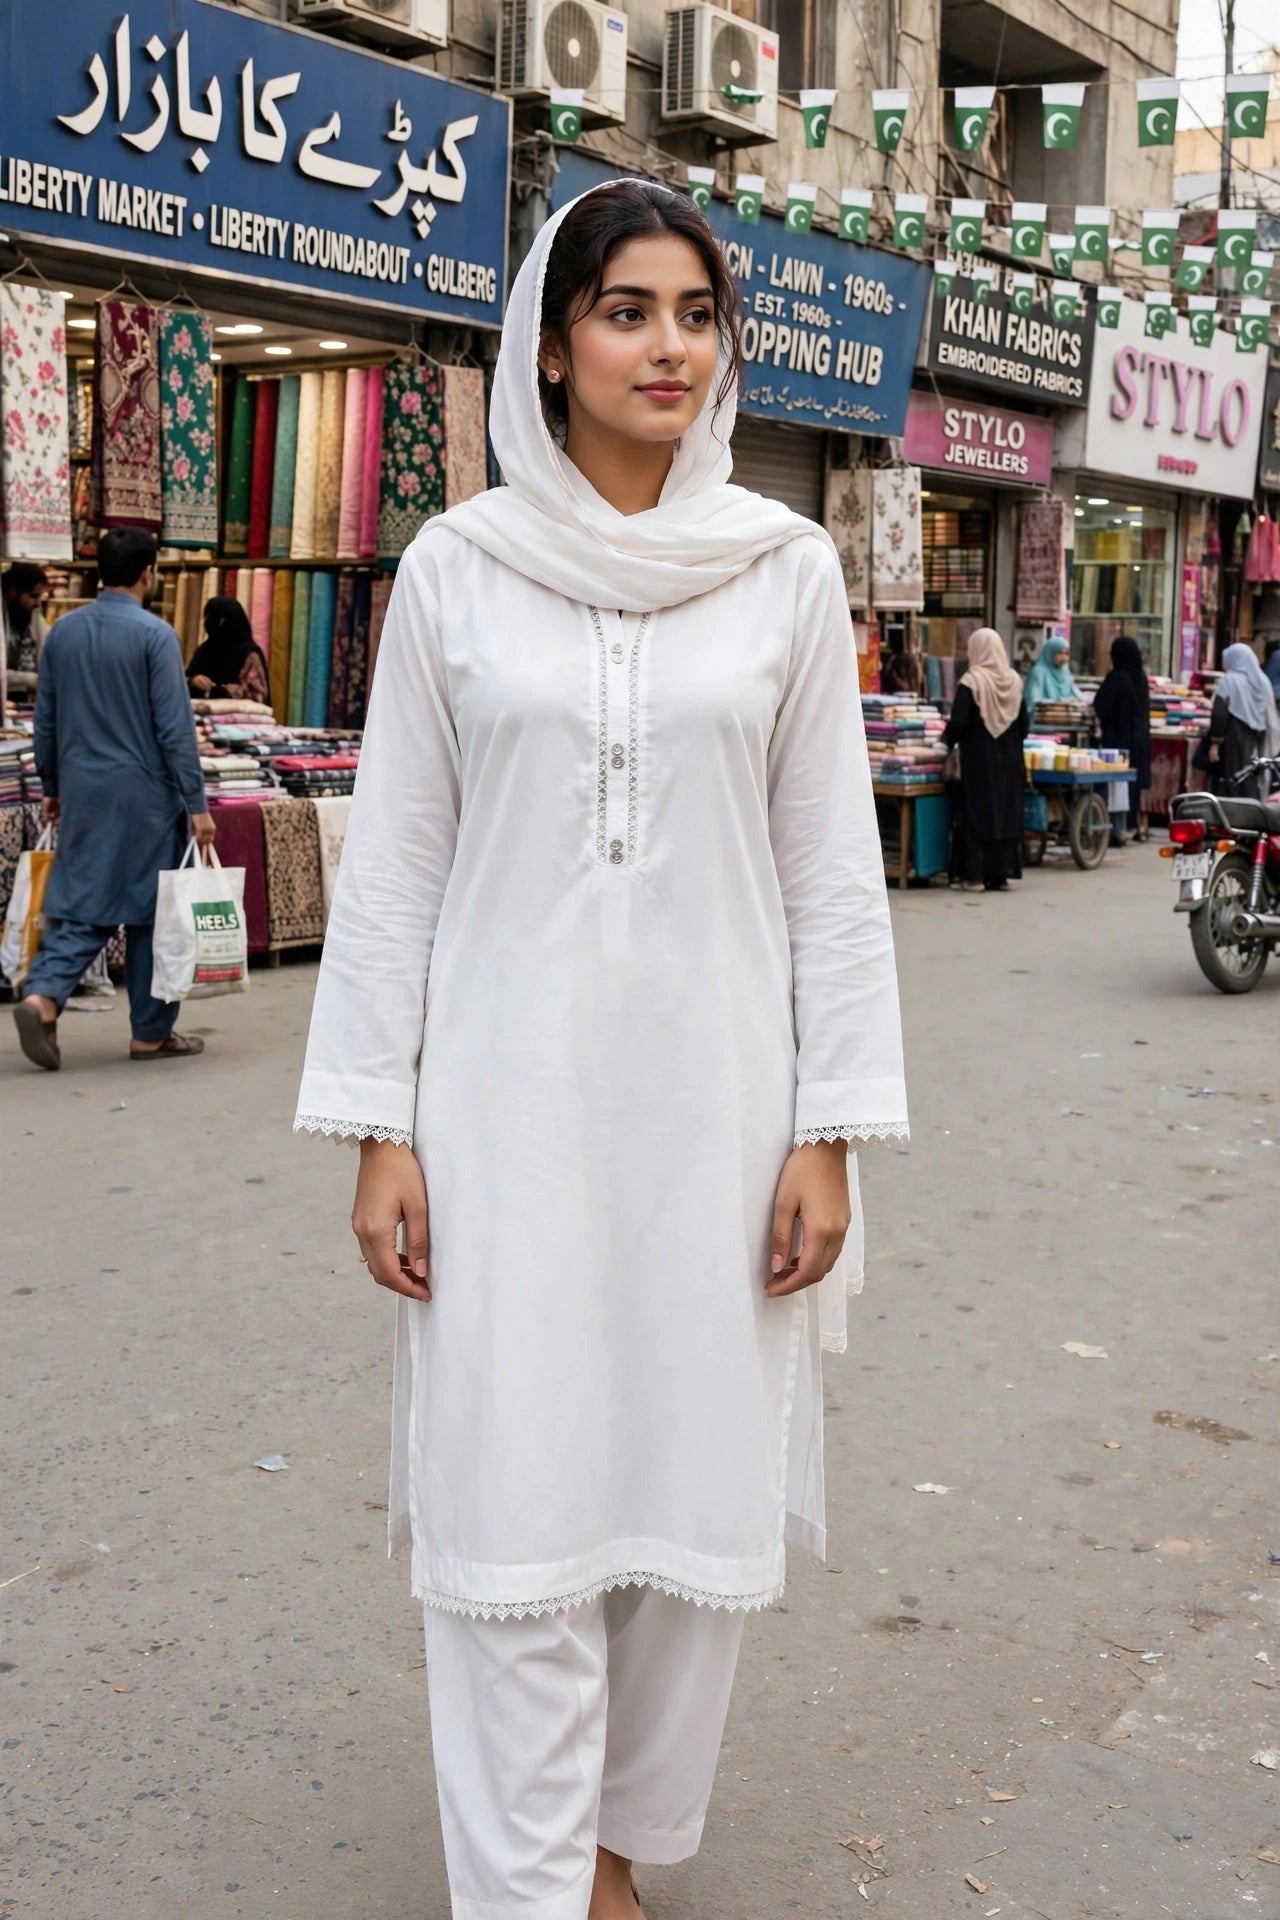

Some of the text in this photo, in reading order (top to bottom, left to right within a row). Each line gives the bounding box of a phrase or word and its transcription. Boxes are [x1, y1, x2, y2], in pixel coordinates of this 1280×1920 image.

[57, 13, 479, 240] کپڑے کا بازار
[0, 155, 92, 217] LIBERTY
[98, 178, 187, 237] MARKET
[210, 204, 289, 260] LIBERTY
[293, 222, 411, 284] ROUNDABOUT
[427, 254, 496, 303] GULBERG
[754, 291, 787, 318] EST.
[791, 301, 831, 328] 1960s
[769, 253, 824, 297] LAWN
[844, 273, 894, 315] 1960s
[943, 294, 1082, 368] KHAN FABRICS
[835, 338, 884, 386] HUB
[938, 342, 1083, 398] EMBROIDERED FABRICS
[1110, 345, 1250, 447] STYLO
[944, 407, 1026, 450] STYLO
[944, 442, 1029, 475] JEWELLERS
[196, 913, 238, 930] HEELS
